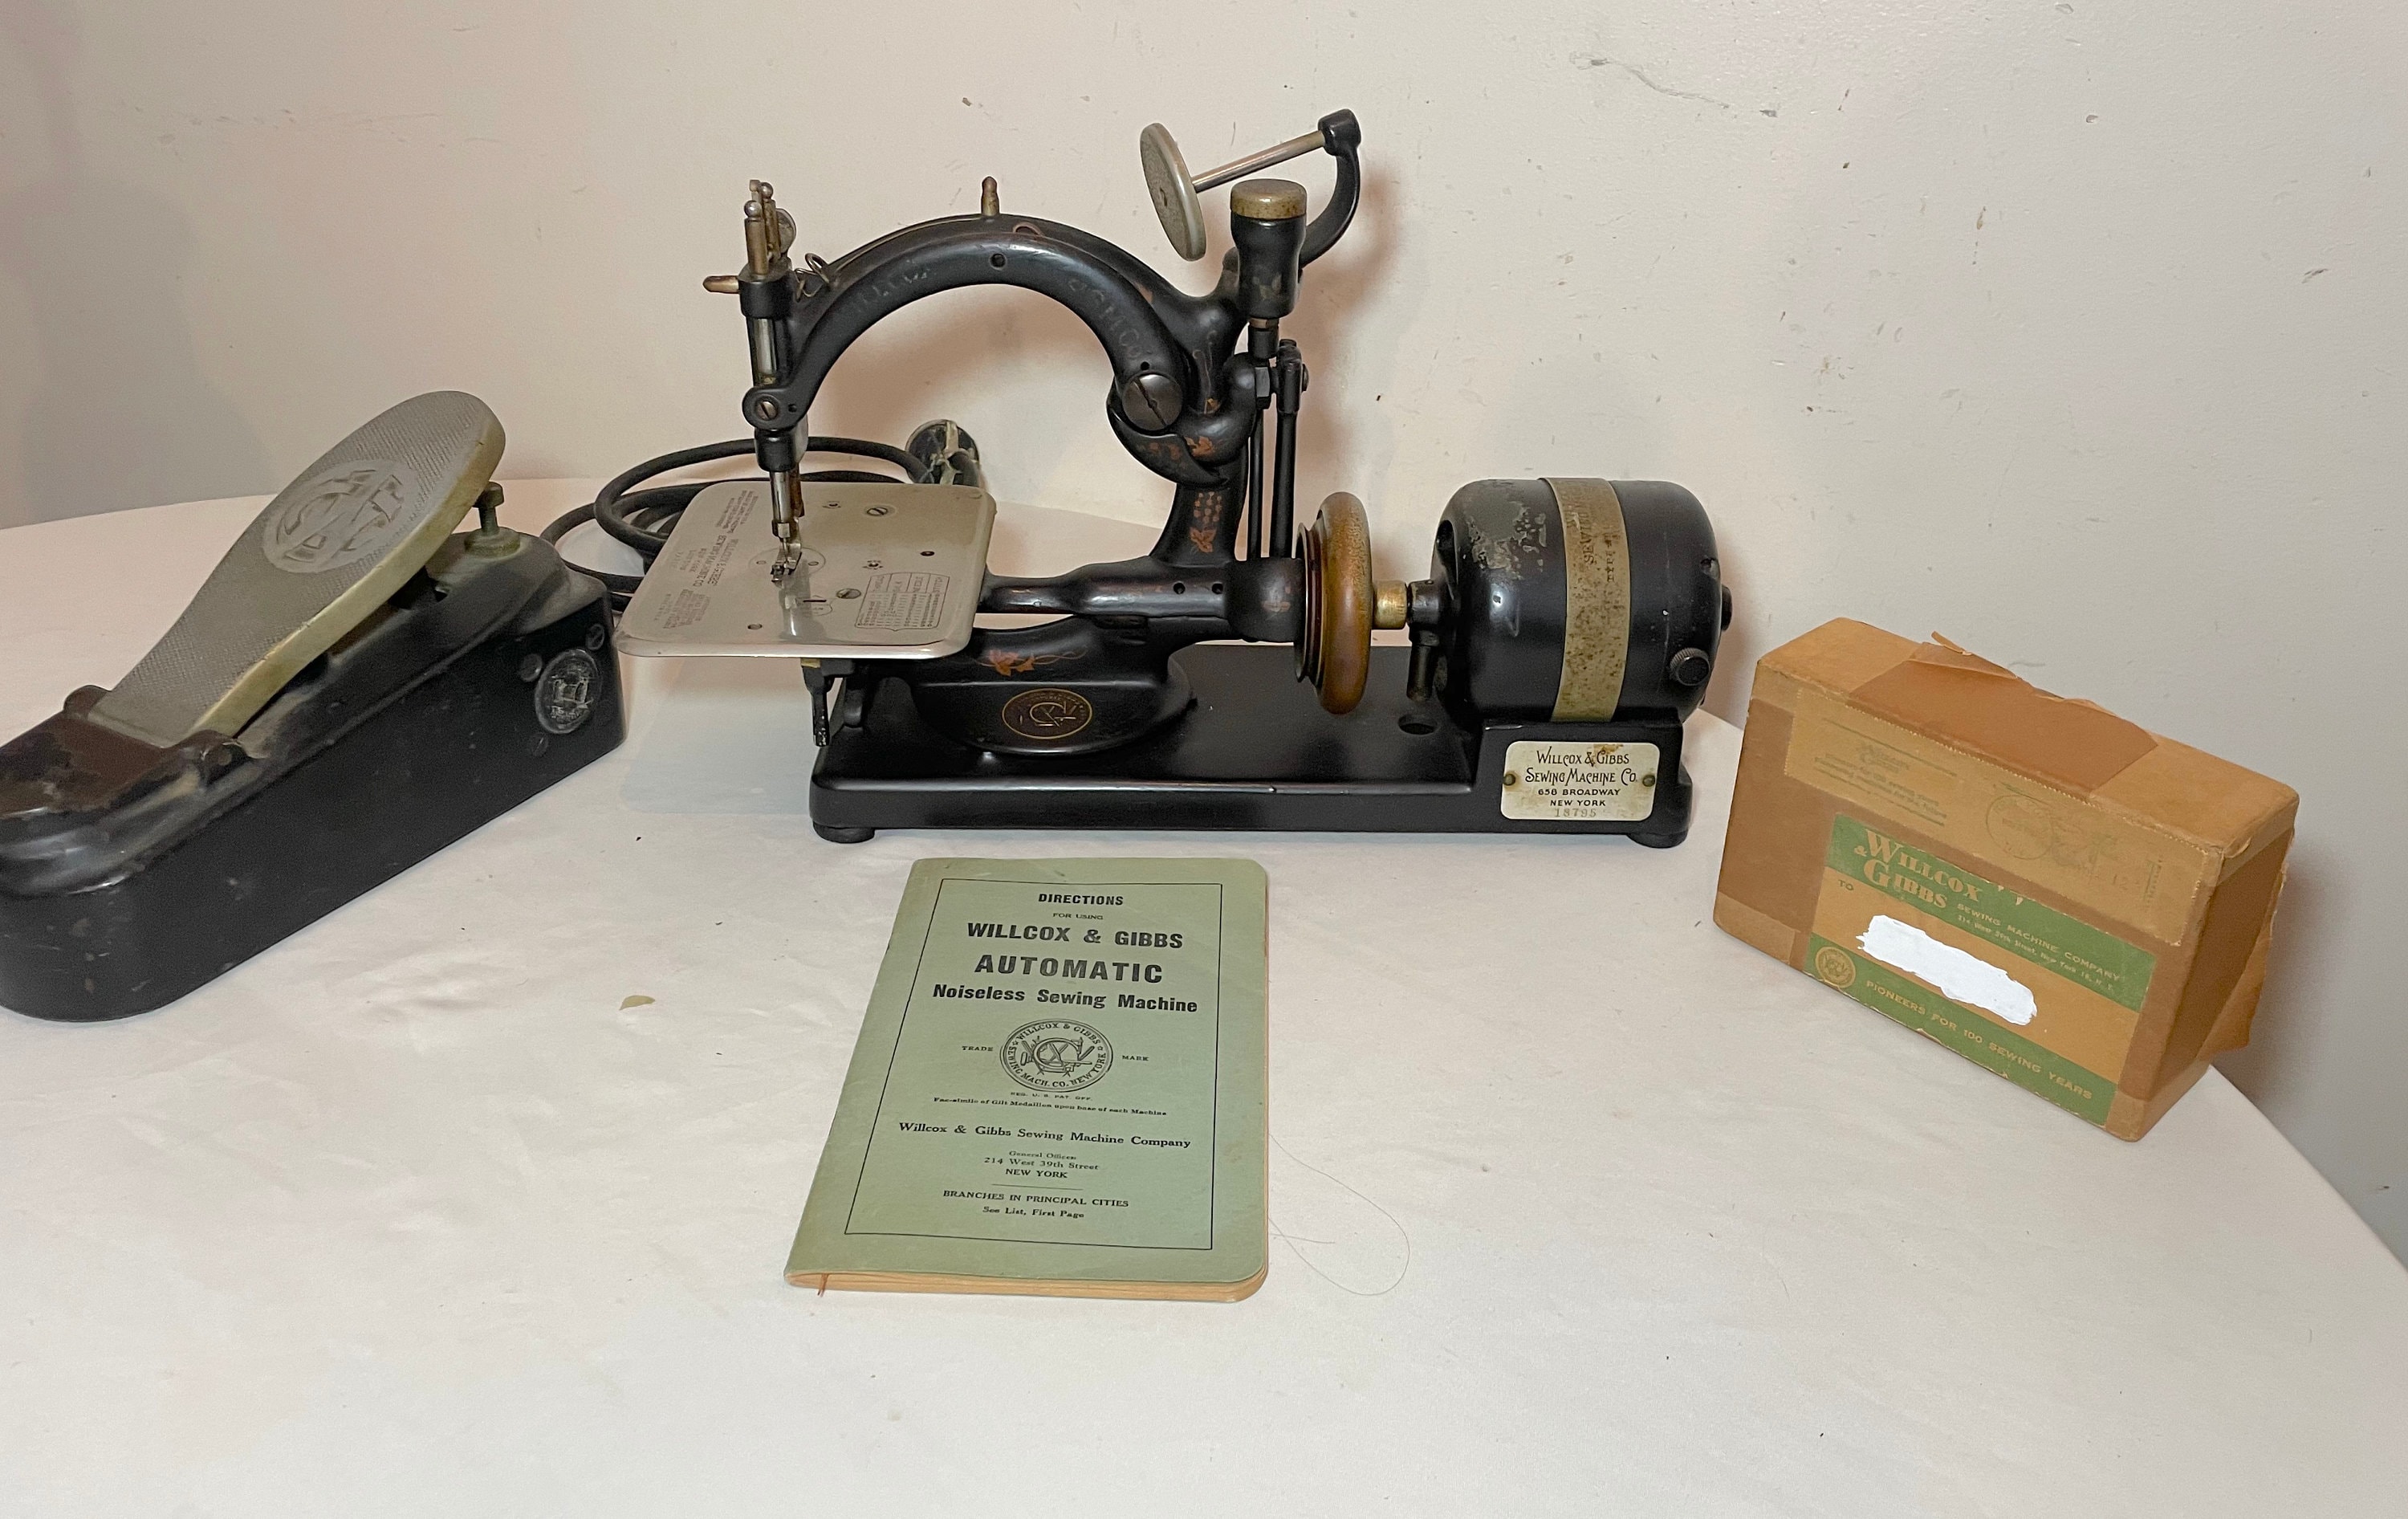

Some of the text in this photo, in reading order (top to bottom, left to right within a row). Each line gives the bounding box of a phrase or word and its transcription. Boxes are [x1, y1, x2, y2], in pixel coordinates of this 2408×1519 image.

[1584, 752, 1596, 767] &
[1854, 845, 1868, 857] &
[1838, 879, 1854, 891] TO
[1039, 894, 1124, 906] DIRECTIONS
[967, 922, 1183, 949] WILLCOX & GIBBS
[1957, 903, 2121, 981] SEWING MACHINE COMPANY
[974, 955, 1163, 983] AUTOMATIC
[933, 983, 1198, 1012] Noiseless Sewing Machine
[1016, 1023, 1059, 1041] WILLCOX
[1074, 1026, 1101, 1045] GIBBS
[1866, 979, 2093, 1100] PIONEERS FOR 100 SEWING YEARS
[1007, 1045, 1023, 1075] SEWING
[1069, 1073, 1092, 1086] NEW
[1092, 1053, 1107, 1074] YORK
[899, 1122, 1191, 1149] Willcox & Gibbs Sewing Machine Company
[984, 1157, 1003, 1165] 214
[1068, 1163, 1099, 1171] Street
[1005, 1168, 1068, 1179] NEW YORK
[943, 1190, 1004, 1200] BRANCHES
[1026, 1195, 1087, 1205] PRINCIPAL
[1092, 1199, 1129, 1207] CITIES
[1005, 1207, 1027, 1216] List,
[1031, 1208, 1055, 1216] First
[1060, 1210, 1084, 1219] Page
